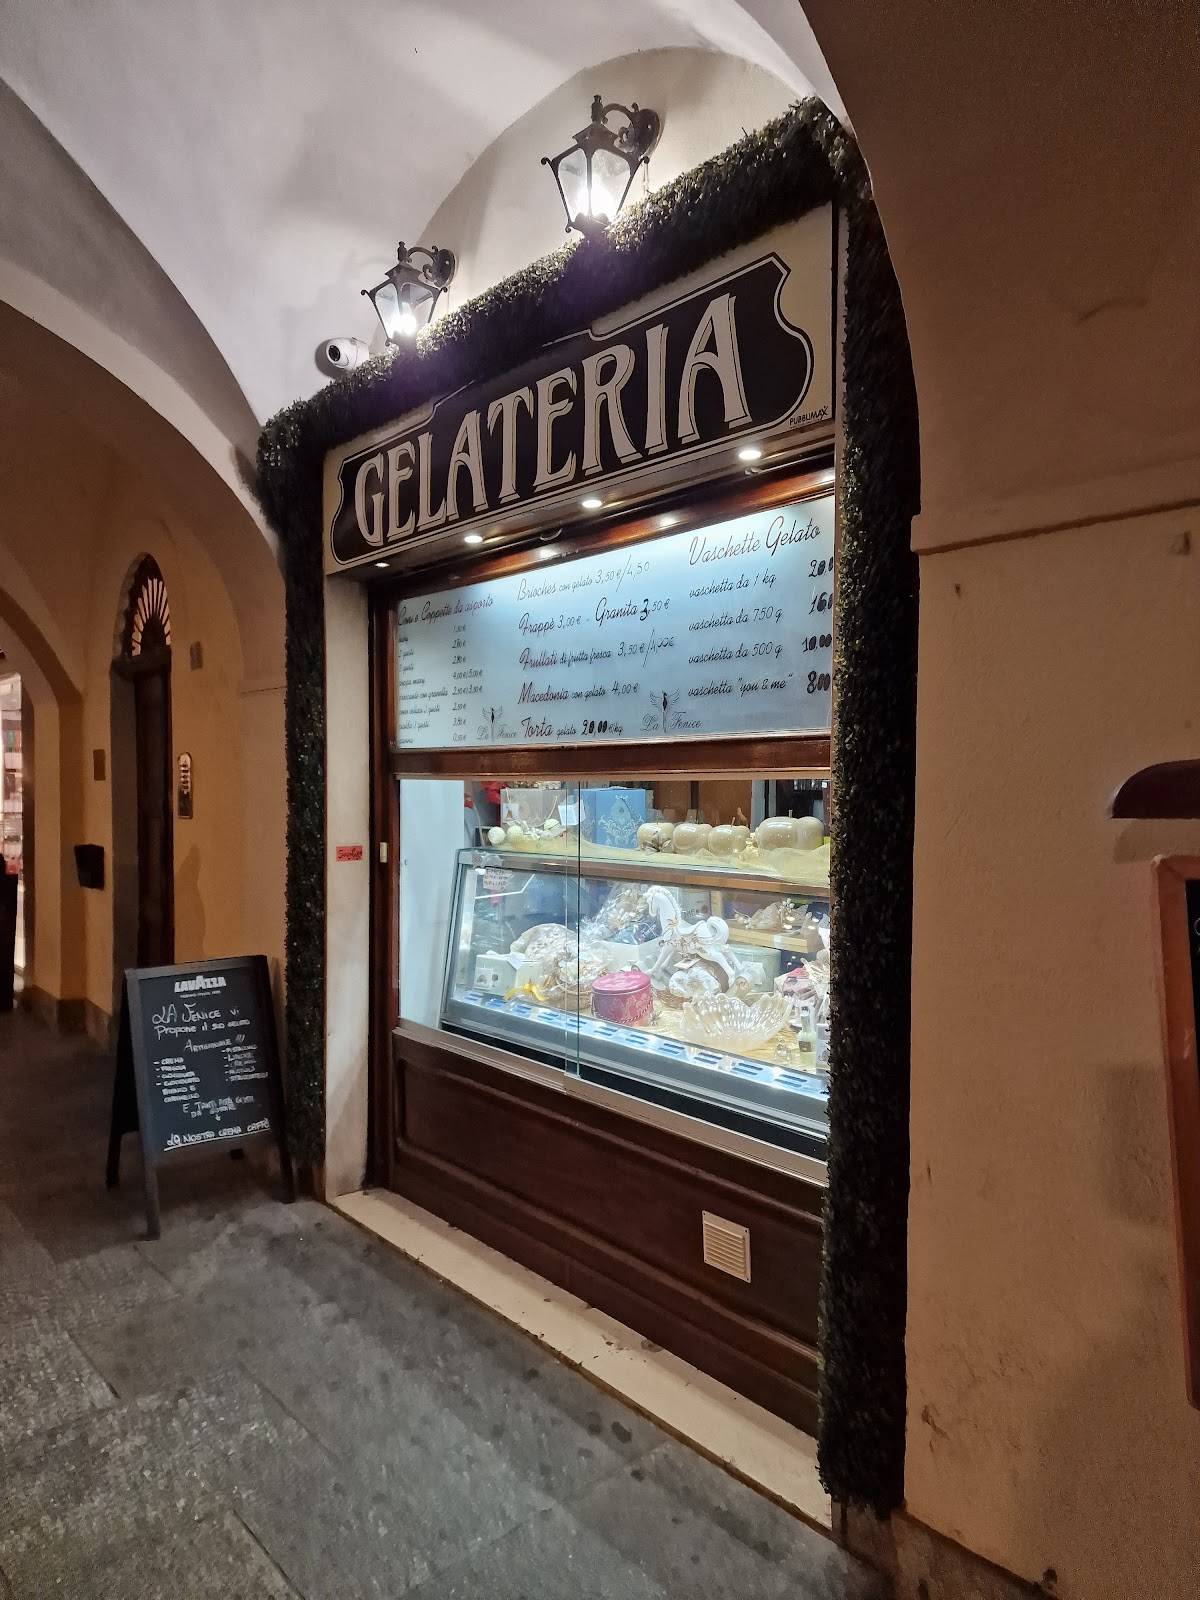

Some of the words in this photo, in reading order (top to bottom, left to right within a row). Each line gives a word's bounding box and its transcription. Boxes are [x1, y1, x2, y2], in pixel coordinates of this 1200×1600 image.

[354, 293, 751, 547] GELATERIA
[689, 532, 760, 566] Vaschette
[765, 515, 820, 557] Gelato
[517, 577, 556, 601] Brioches
[571, 575, 593, 592] gelato
[689, 577, 733, 598] vaschetta
[736, 573, 749, 589] da
[763, 568, 777, 588] kg
[595, 596, 638, 628] Granita
[688, 612, 733, 631] vaschetta
[736, 608, 749, 624] da
[753, 606, 774, 621] 750
[776, 608, 783, 624] g
[519, 647, 557, 671] Frullati
[688, 645, 733, 664] vaschetta
[735, 642, 749, 659] da
[751, 641, 773, 657] 500
[775, 643, 783, 659] g
[517, 681, 569, 704] Macedonia
[584, 684, 606, 701] gelato
[688, 679, 732, 697] vaschetta
[521, 716, 553, 738] Torta
[174, 975, 227, 993] LAVAZZA
[182, 1103, 190, 1113] E
